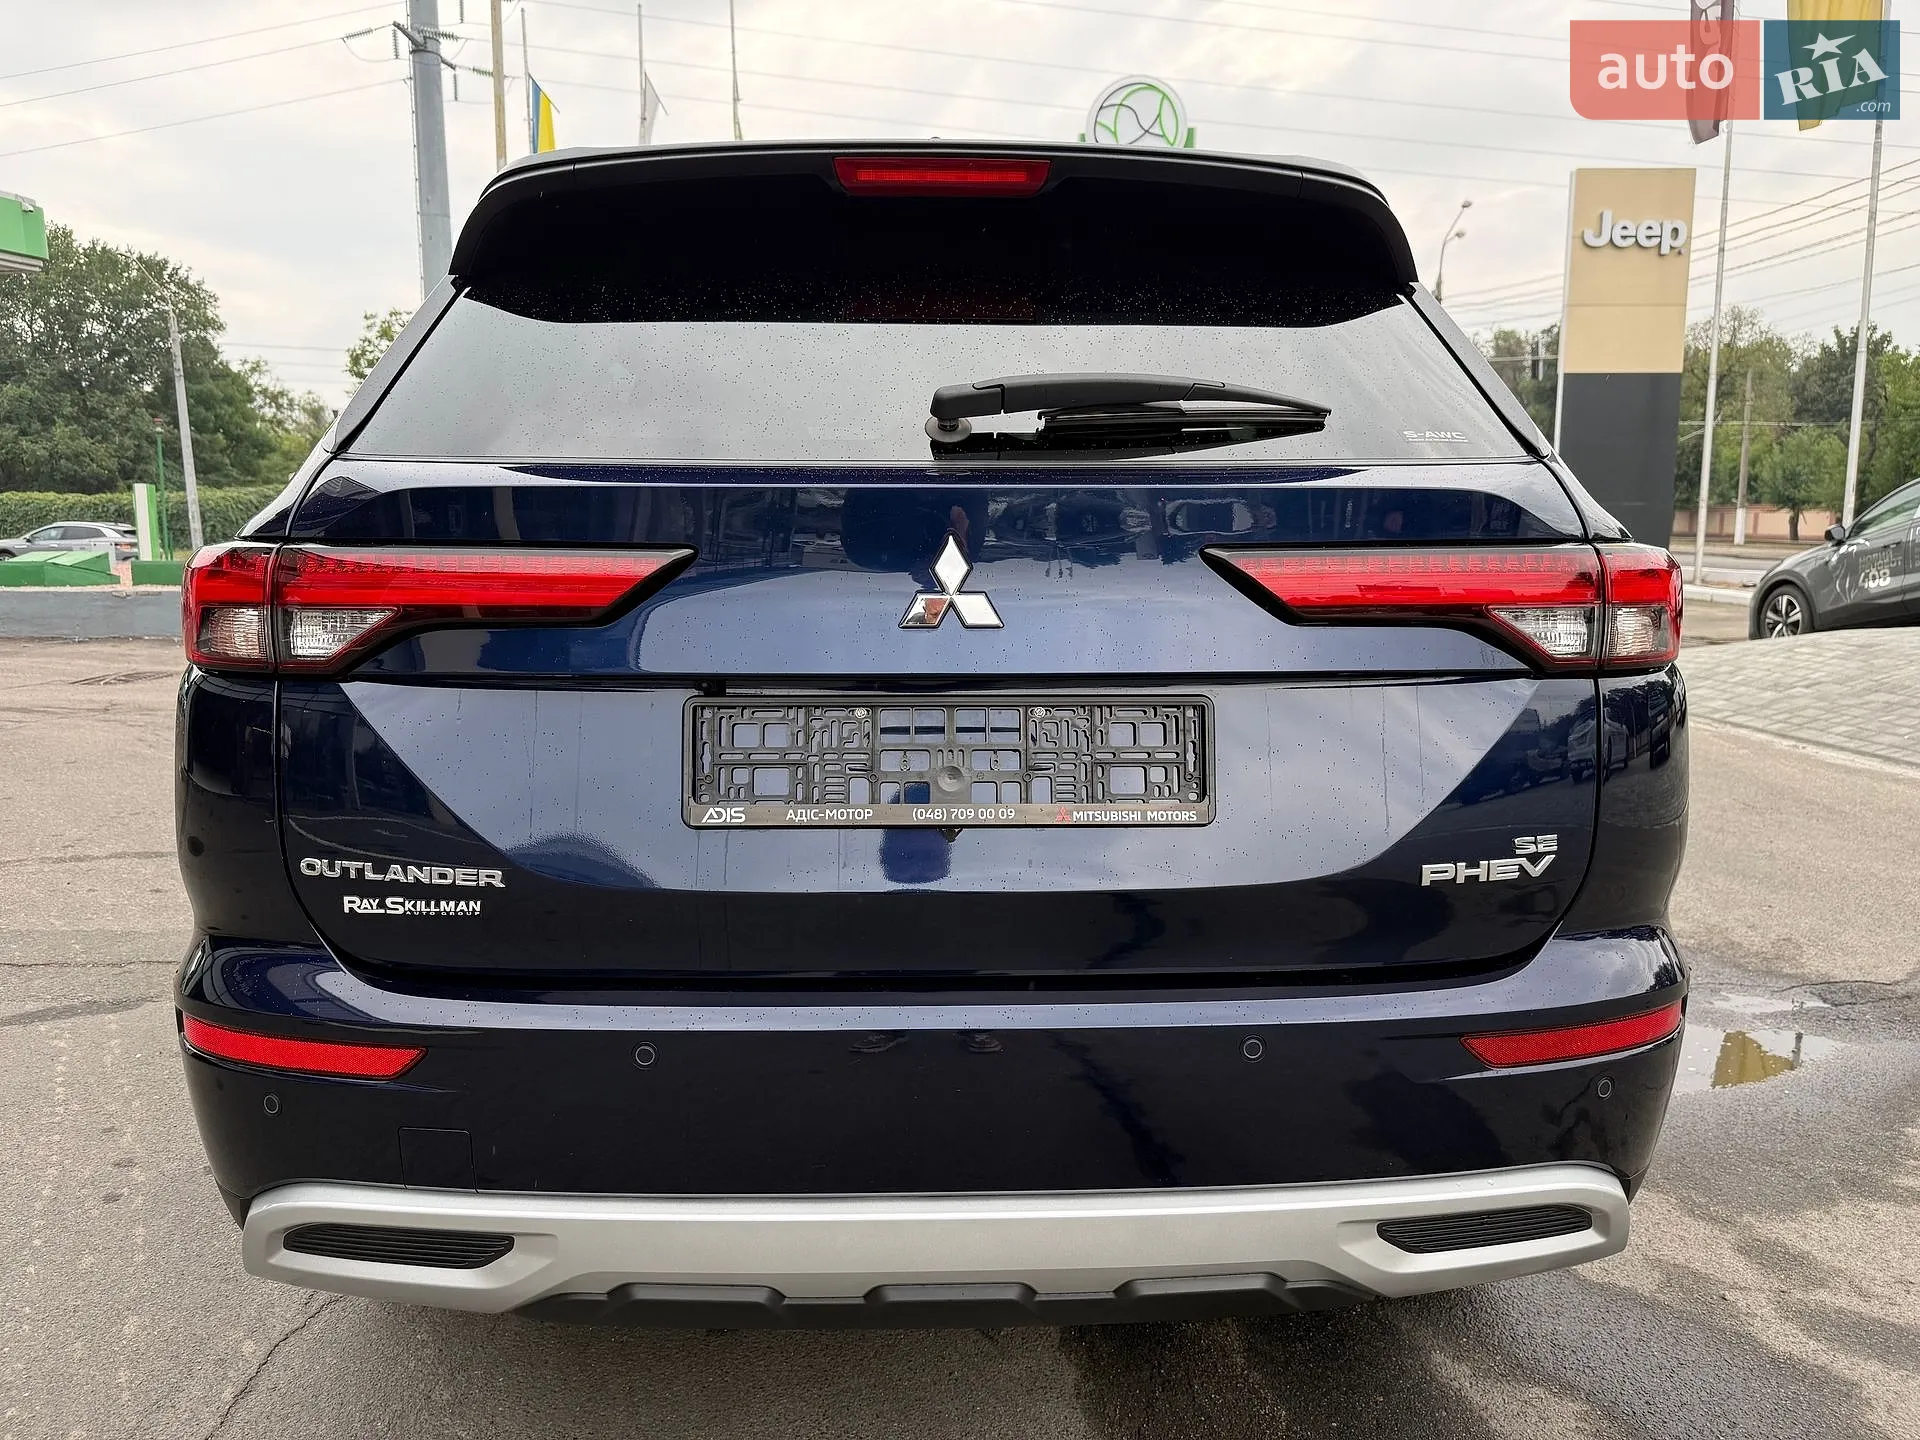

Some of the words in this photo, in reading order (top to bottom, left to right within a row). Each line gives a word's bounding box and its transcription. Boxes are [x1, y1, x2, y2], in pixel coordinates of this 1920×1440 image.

[1583, 209, 1689, 255] Jeep
[1403, 430, 1467, 440] S-AWC
[1858, 569, 1891, 589] 408
[701, 807, 746, 823] ADIS
[786, 808, 873, 822] АДІС-МОТОР
[912, 807, 947, 821] (048)
[950, 808, 975, 820] 709
[978, 808, 995, 820] 00
[998, 808, 1015, 820] 09
[1073, 810, 1141, 821] MITSUBISHI
[1147, 810, 1197, 821] MOTORS
[1514, 834, 1558, 855] SE
[300, 857, 506, 888] OUTLANDER
[1421, 855, 1556, 887] PHEV
[344, 896, 385, 914] RAY
[386, 896, 481, 914] SKILLMAN
